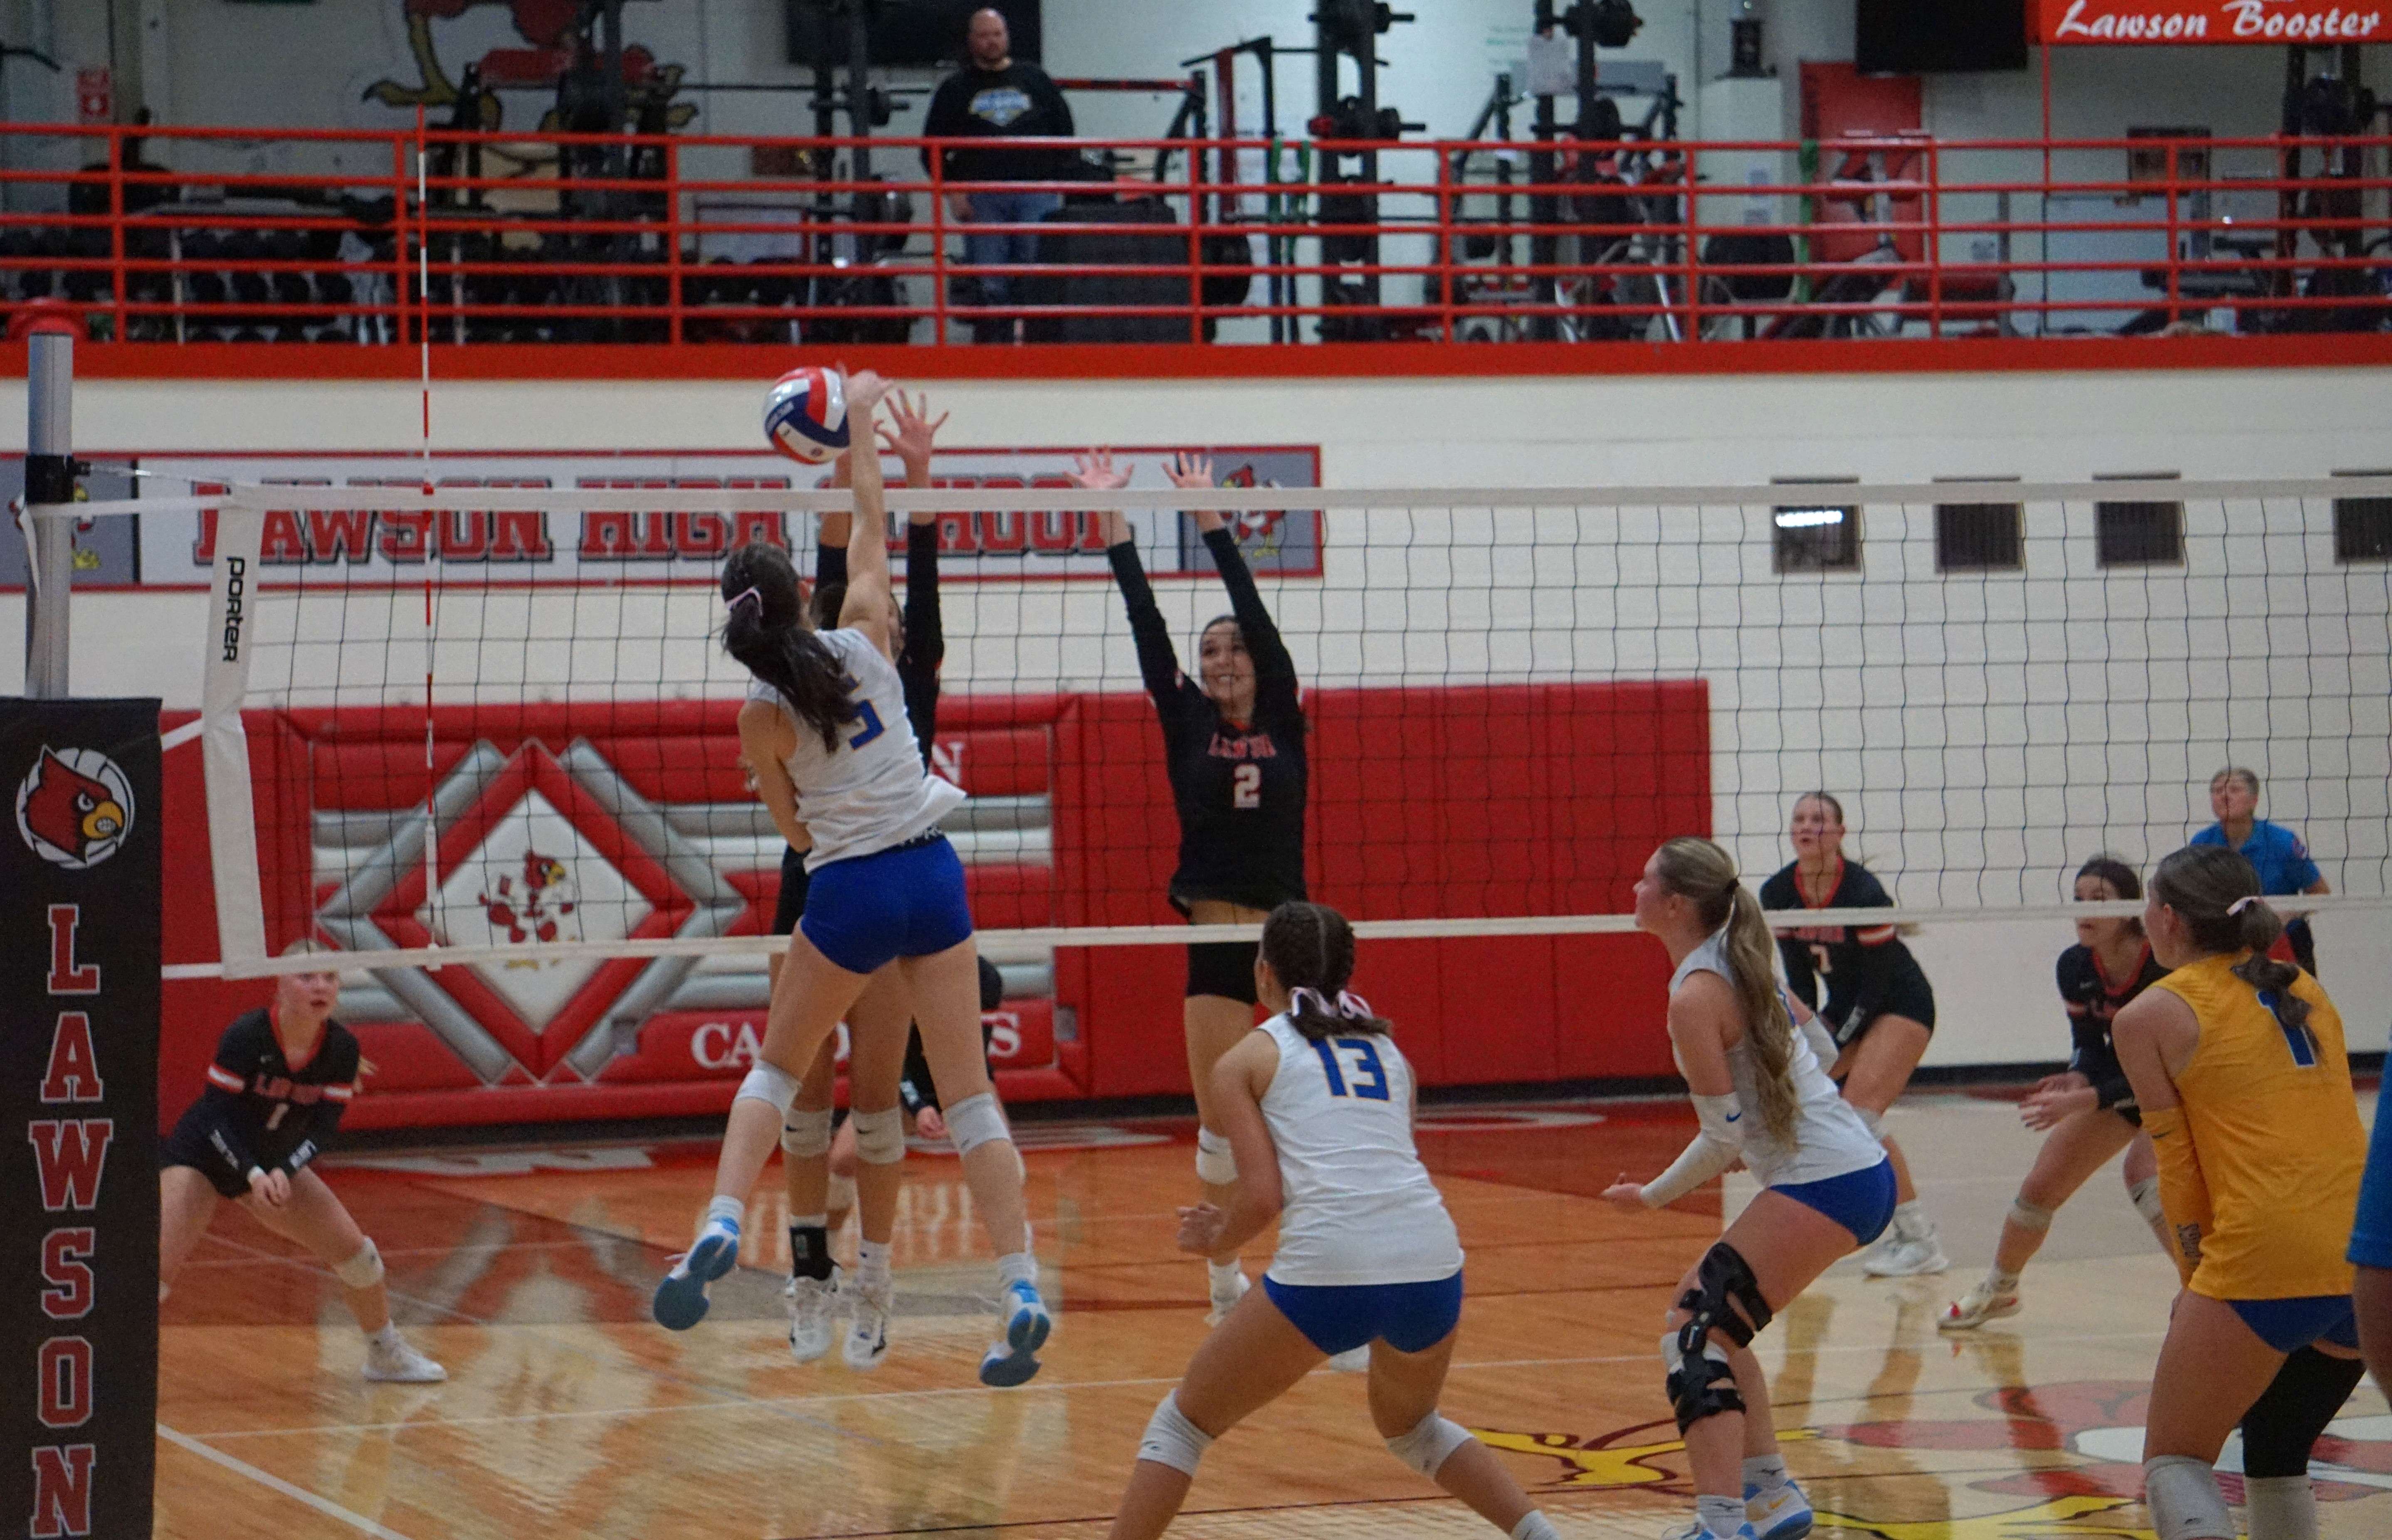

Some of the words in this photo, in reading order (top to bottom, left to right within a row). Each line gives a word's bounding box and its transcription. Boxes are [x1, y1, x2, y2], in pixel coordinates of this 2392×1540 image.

[2056, 0, 2208, 38] Lawson
[2221, 0, 2381, 39] Booster
[1234, 764, 1261, 808] 2
[1307, 1037, 1390, 1102] 13
[29, 904, 113, 1538] LAWSON
